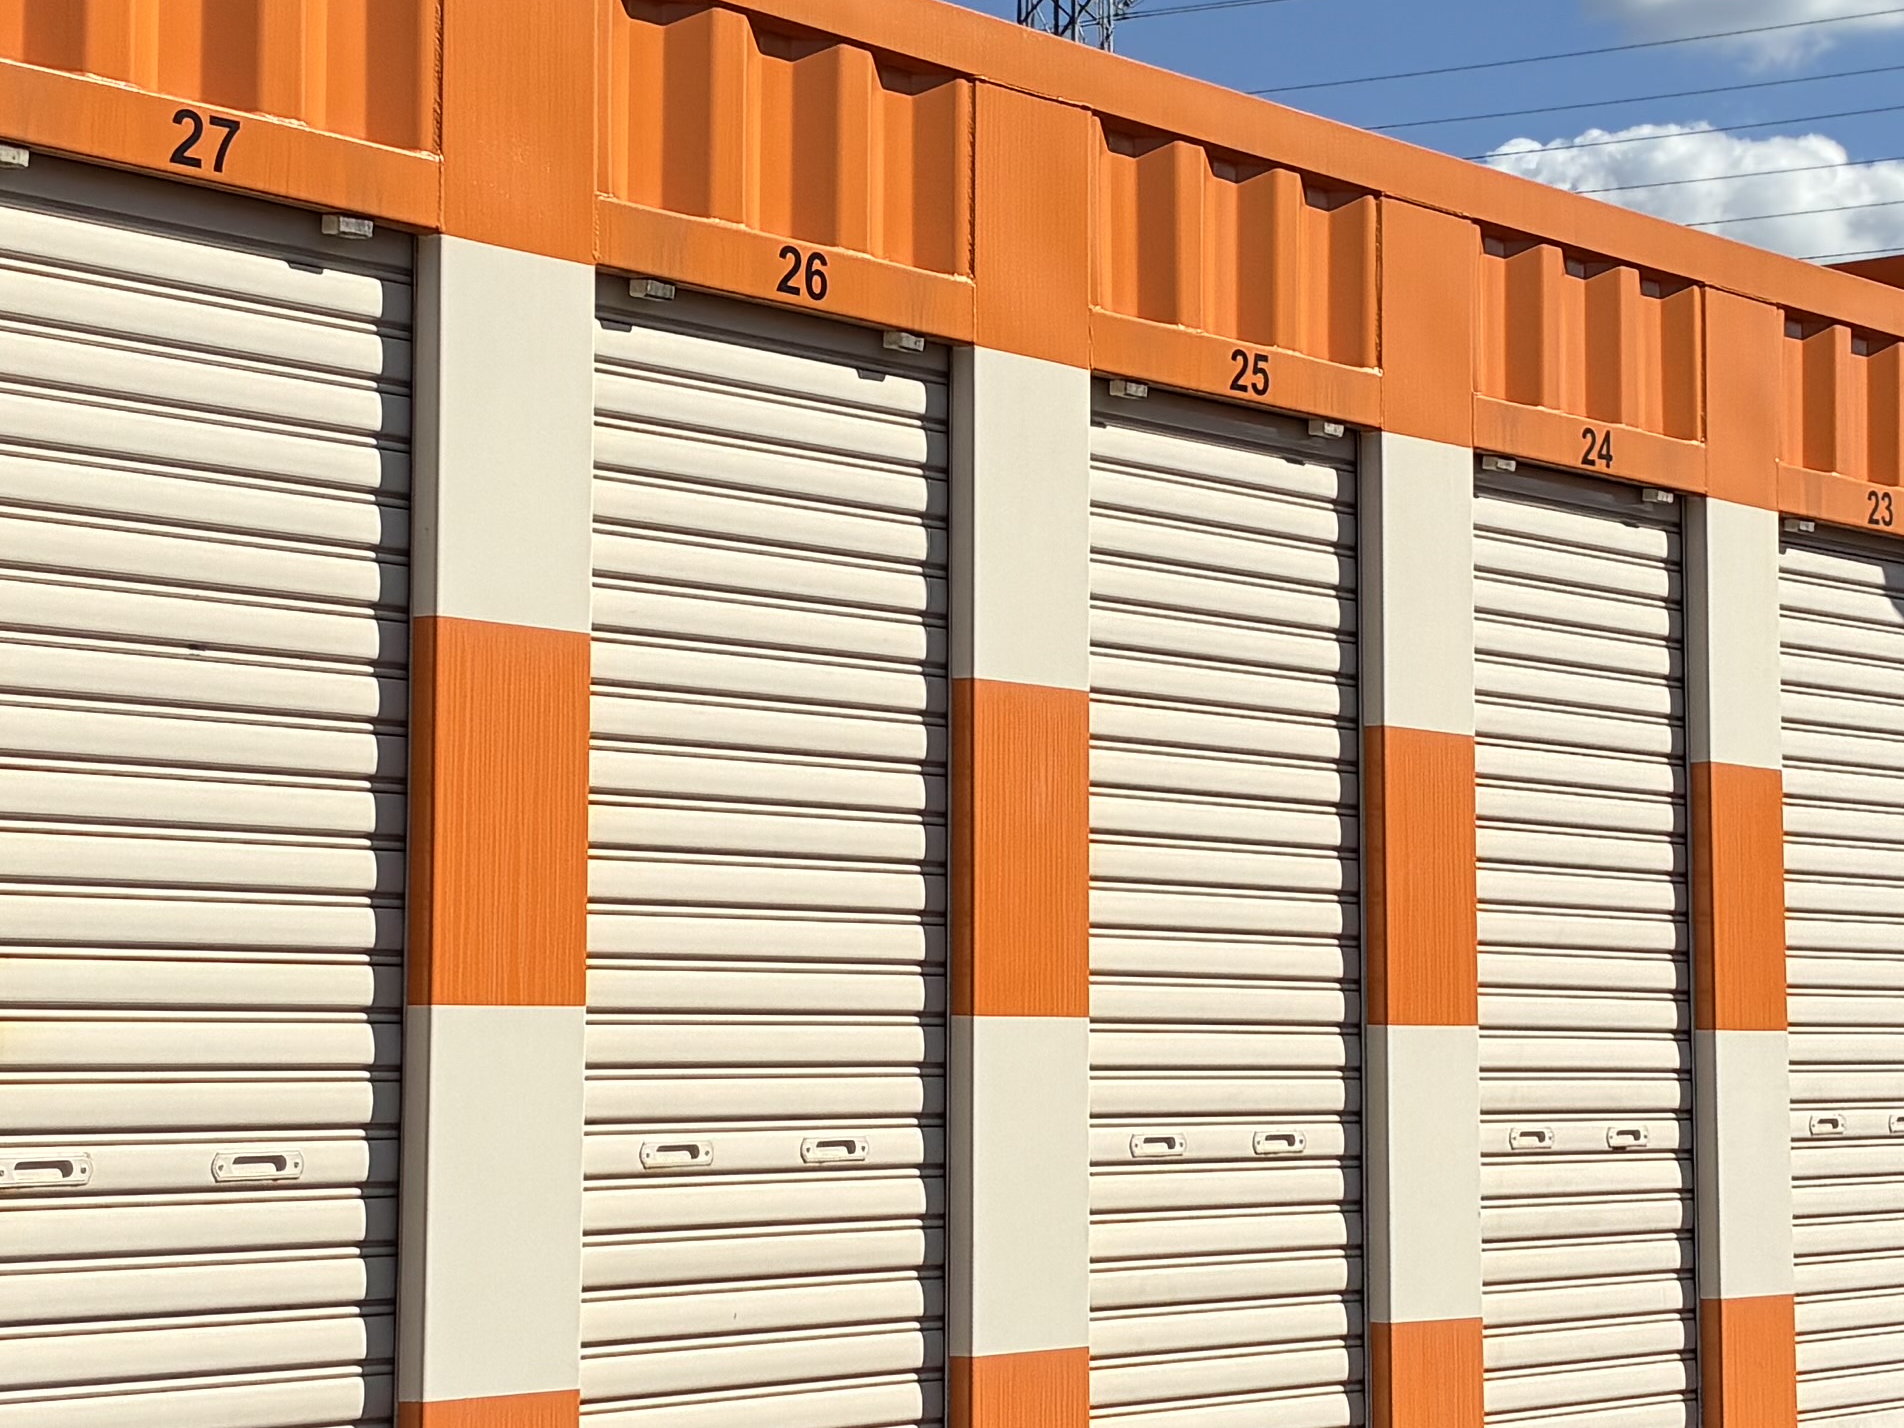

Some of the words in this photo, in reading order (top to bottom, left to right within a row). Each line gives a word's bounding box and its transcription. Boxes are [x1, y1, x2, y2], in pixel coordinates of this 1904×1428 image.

[169, 108, 241, 173] 27
[776, 245, 829, 301] 26
[1229, 348, 1270, 397] 25
[1580, 426, 1613, 470] 24
[1867, 490, 1894, 527] 23
